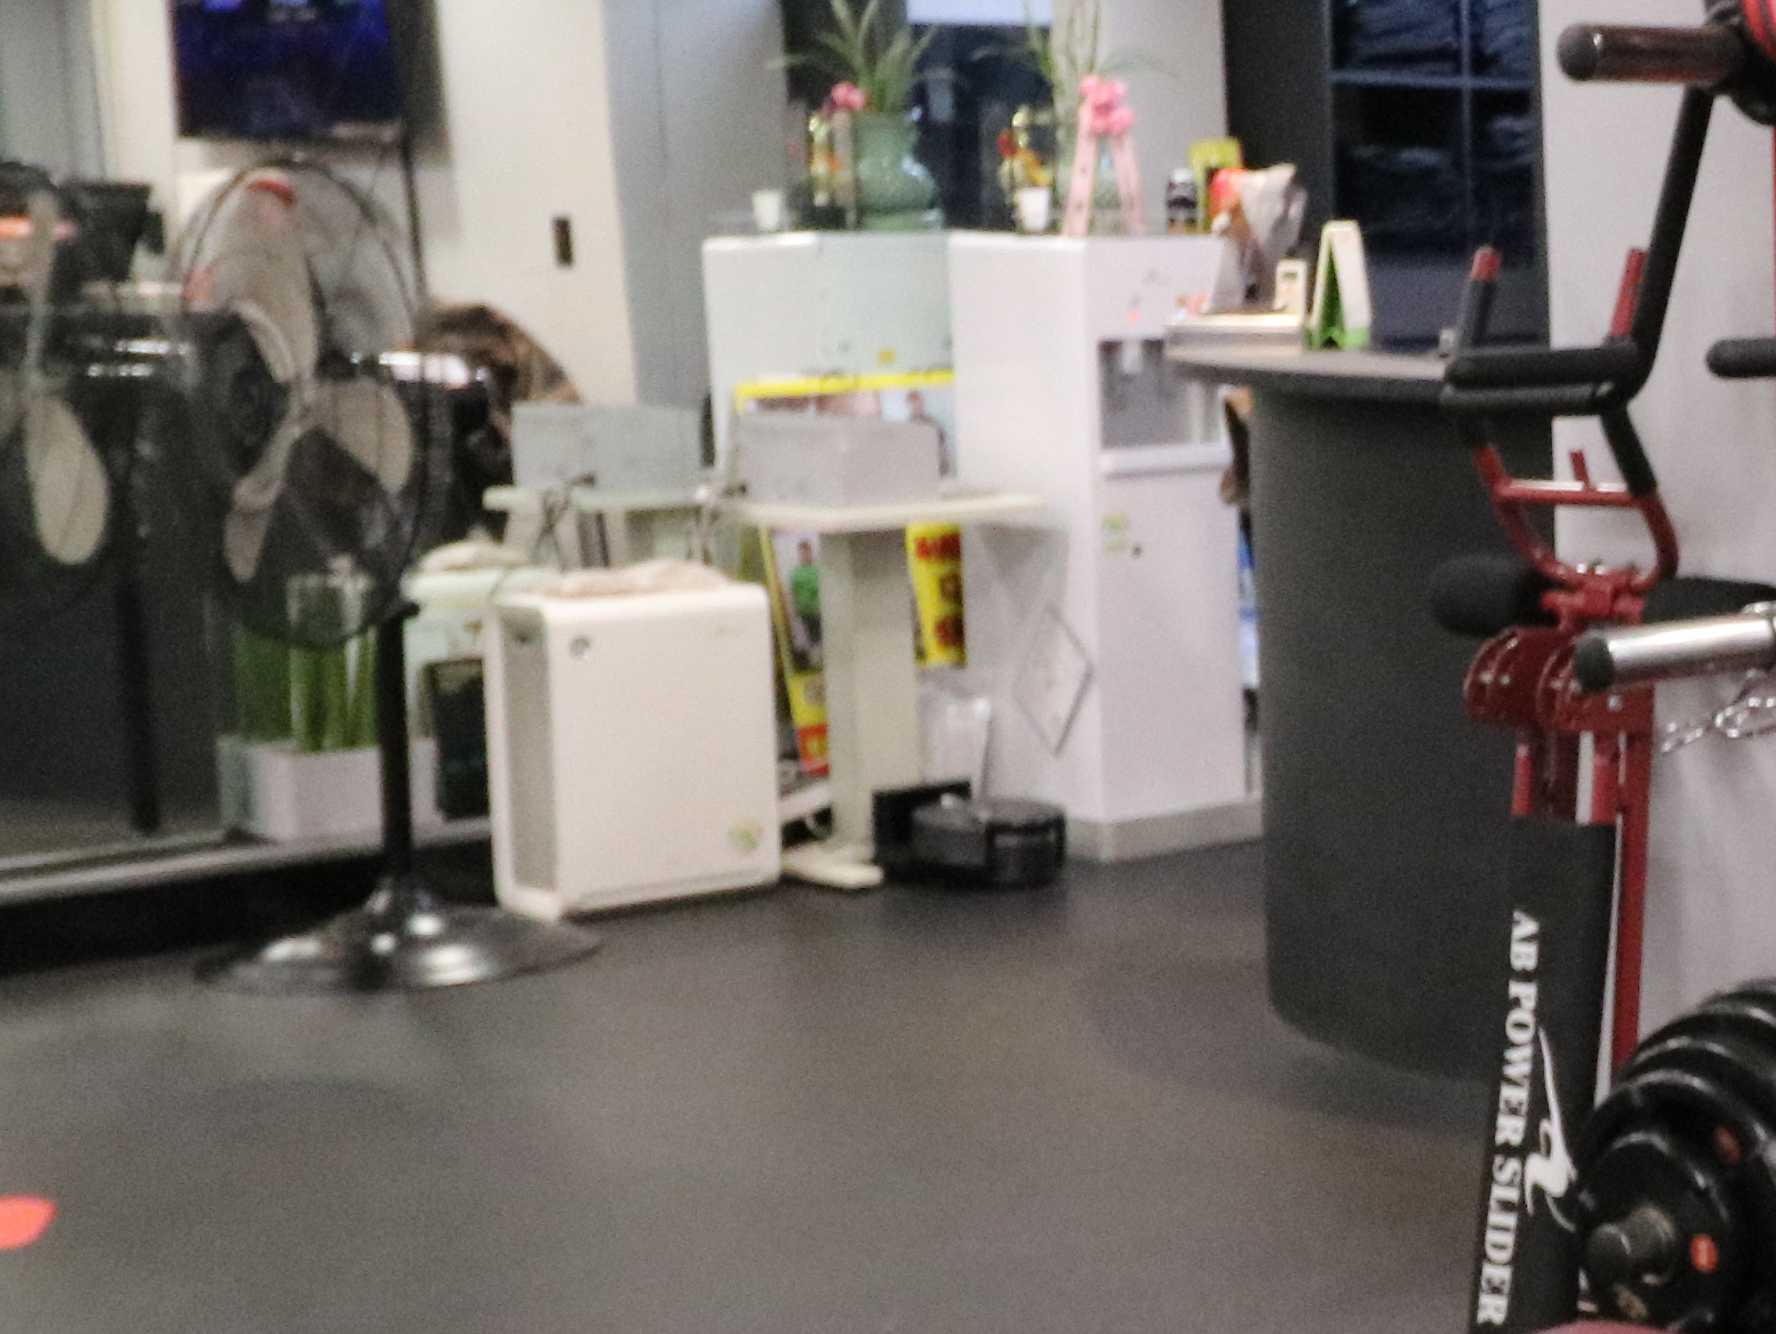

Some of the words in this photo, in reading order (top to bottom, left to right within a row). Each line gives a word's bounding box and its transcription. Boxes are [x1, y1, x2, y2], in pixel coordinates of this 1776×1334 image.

[1509, 910, 1540, 971] AB
[1494, 978, 1539, 1147] POWER
[1477, 1155, 1522, 1325] SLIDER
